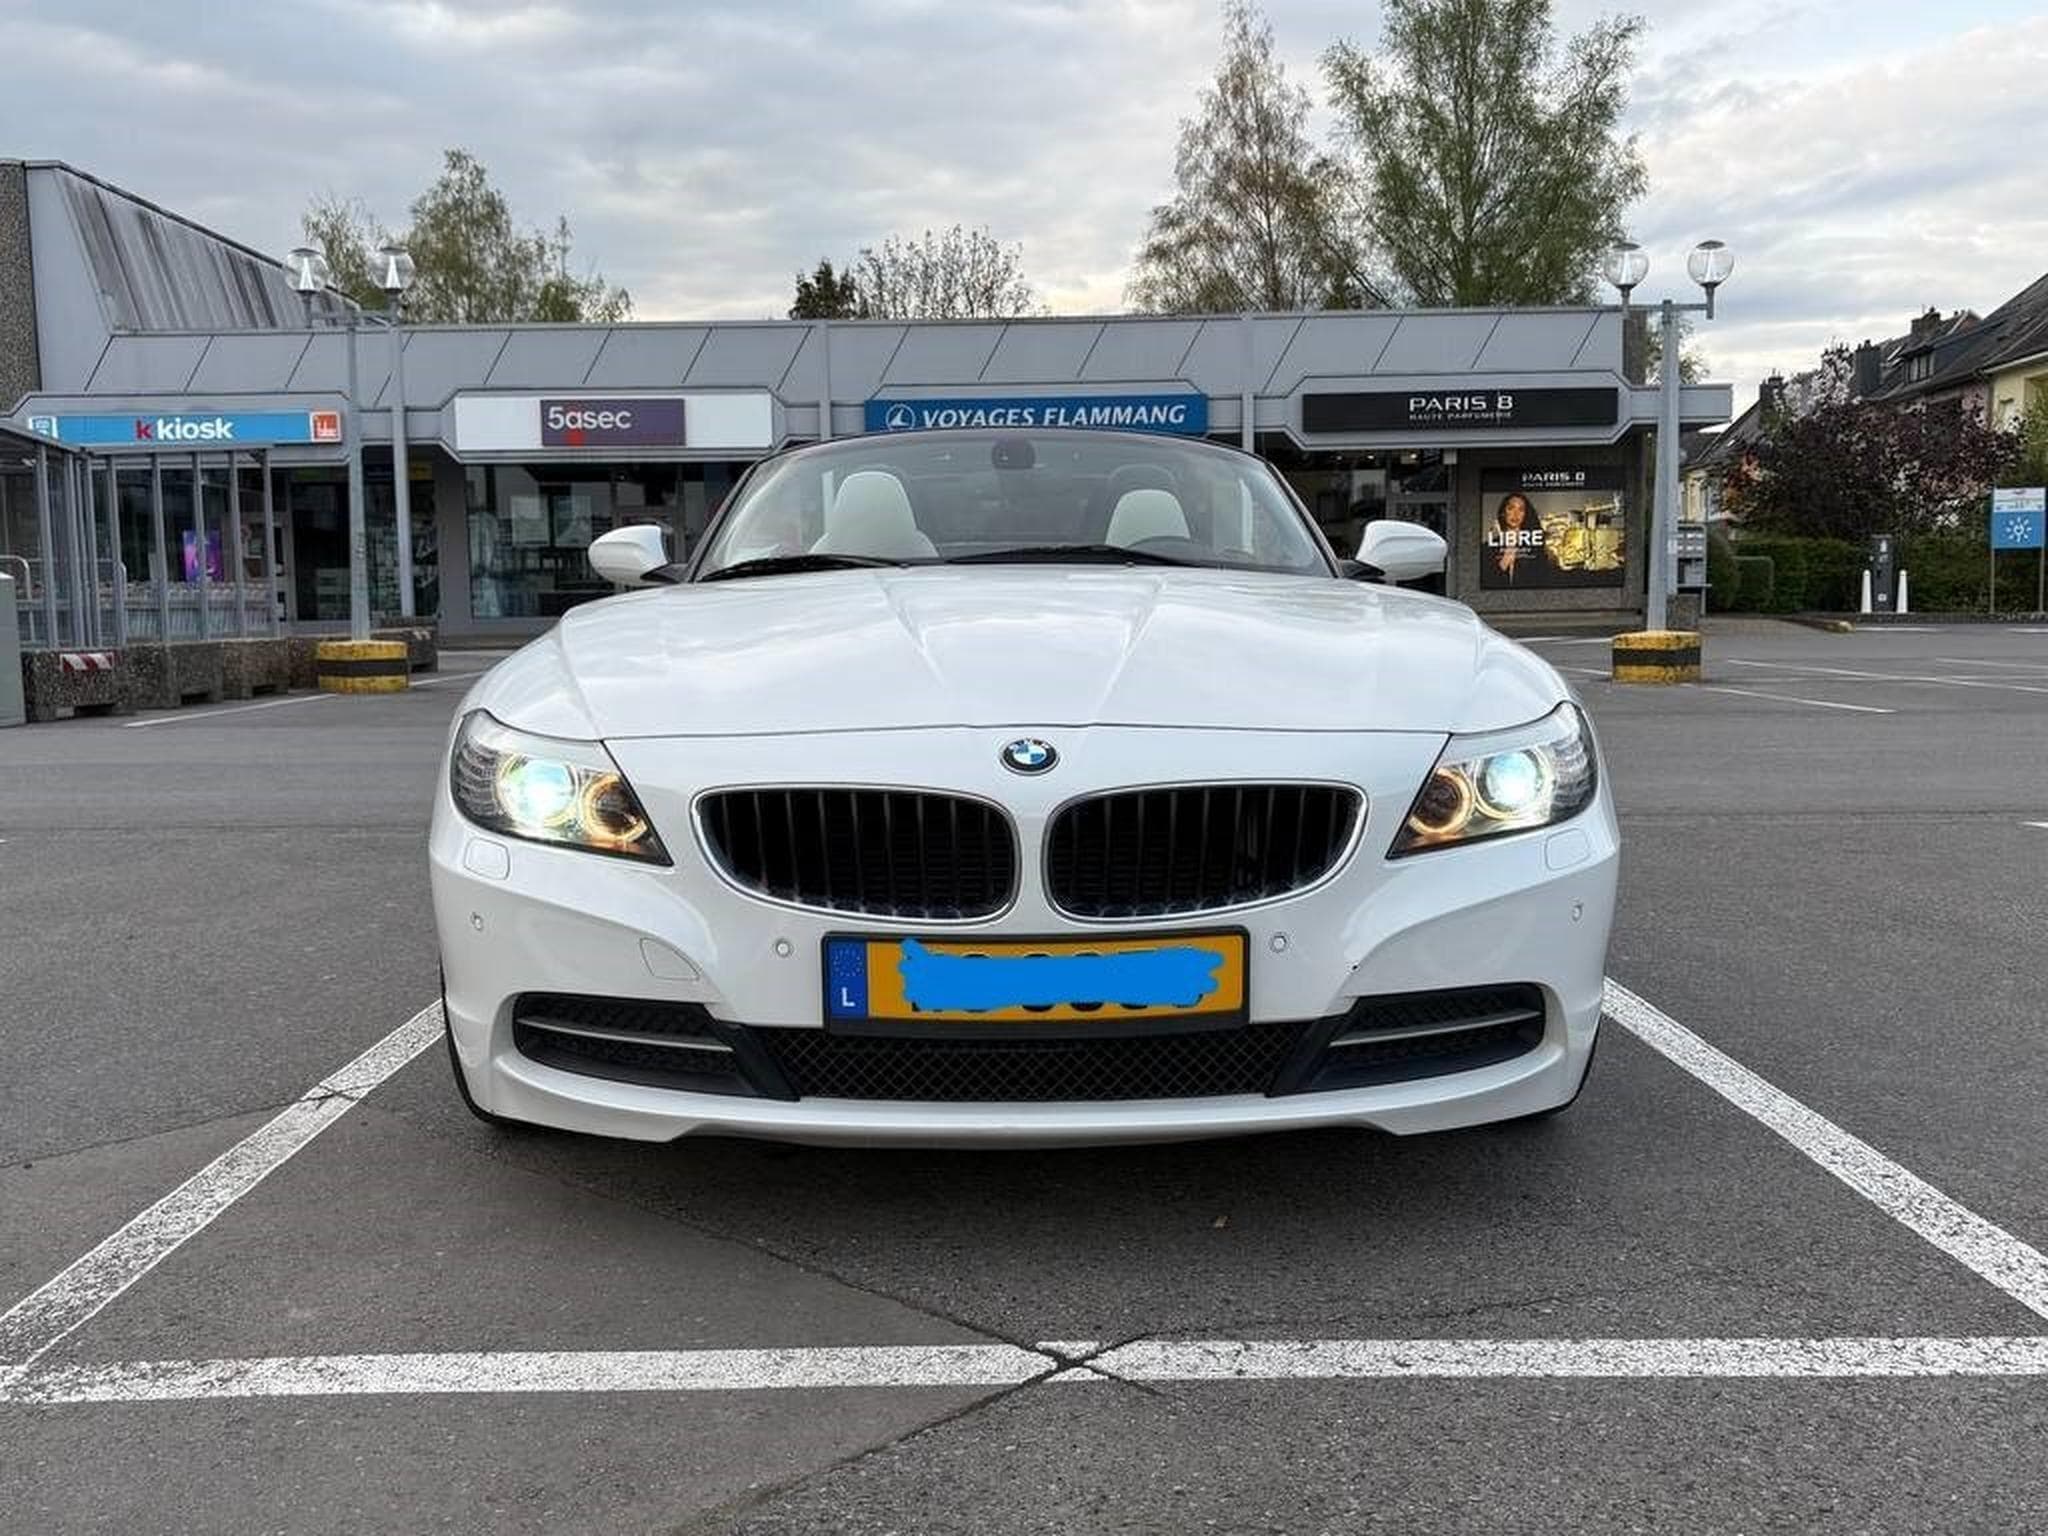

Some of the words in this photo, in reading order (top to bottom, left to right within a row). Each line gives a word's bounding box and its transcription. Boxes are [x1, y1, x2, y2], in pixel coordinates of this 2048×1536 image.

[1409, 395, 1487, 412] PARIS
[547, 406, 632, 430] 5asec
[922, 408, 1036, 429] VOYAGES
[1043, 404, 1187, 426] FLAMMANG
[157, 417, 234, 440] kiosk
[1487, 529, 1544, 547] LIBRE
[841, 987, 856, 1007] L
